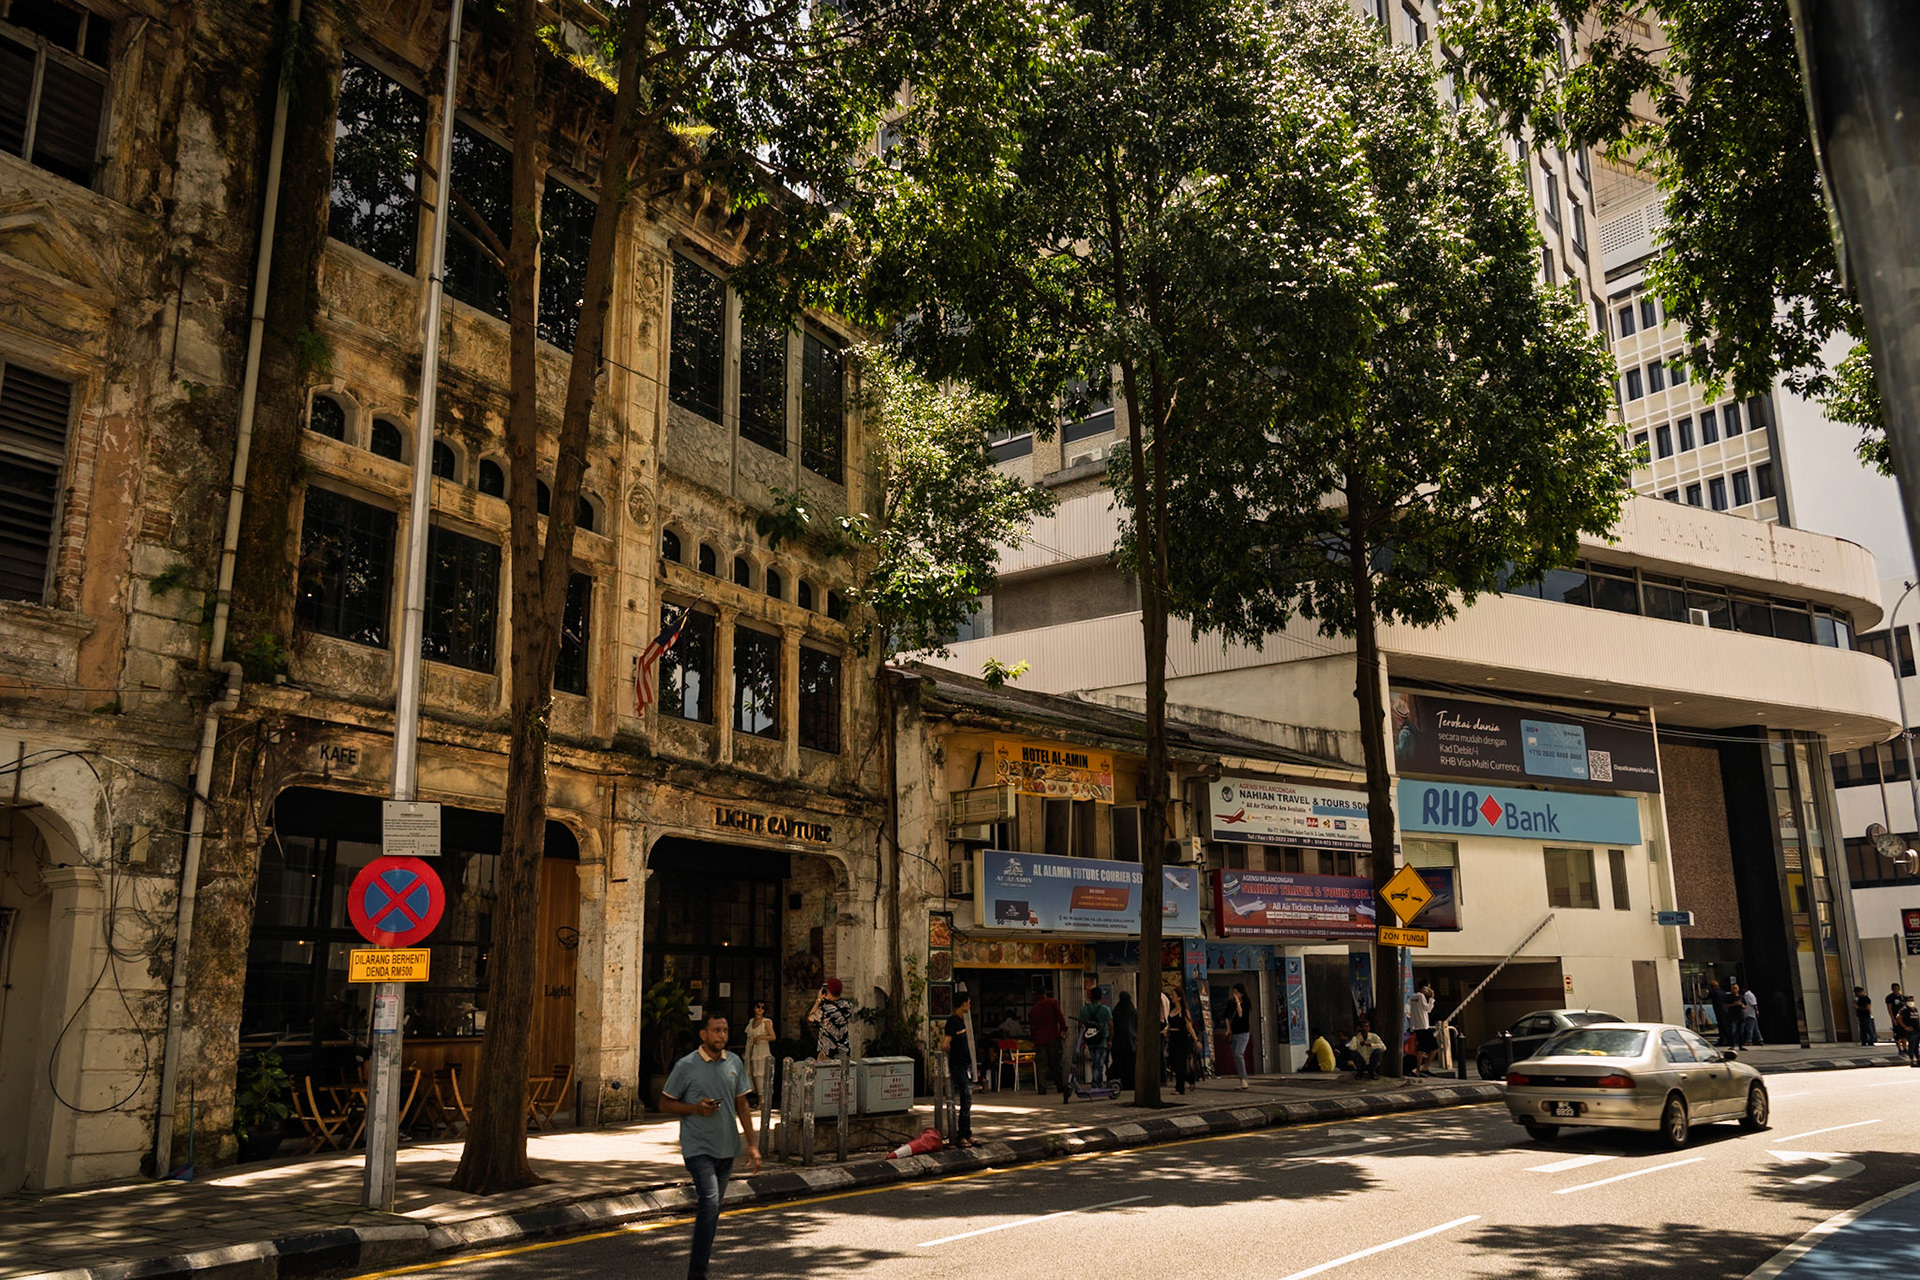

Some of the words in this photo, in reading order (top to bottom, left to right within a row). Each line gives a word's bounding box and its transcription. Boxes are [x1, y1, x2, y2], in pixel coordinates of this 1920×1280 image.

[1436, 710, 1472, 729] Terokai
[1473, 718, 1500, 732] dunia
[1438, 733, 1460, 742] secara
[1460, 735, 1483, 744] mudah
[1483, 737, 1507, 747] dengan
[320, 744, 357, 765] KAFE
[1440, 744, 1453, 753] Kad
[1022, 746, 1050, 764] HOTEL
[1051, 751, 1088, 769] AL-AMIN
[1440, 756, 1456, 767] RHB
[1456, 758, 1472, 768] Visa
[1472, 759, 1490, 769] Multi
[1490, 760, 1521, 773] Currency.
[1259, 784, 1296, 794] PELANCONGAN
[1239, 790, 1275, 801] NAHIAN
[1277, 794, 1310, 805] TRAVEL
[1312, 797, 1319, 806] &
[1321, 798, 1350, 809] TOURS
[1422, 788, 1479, 827] RHB
[1504, 802, 1560, 834] Bank
[715, 807, 764, 832] LIGHT
[767, 816, 832, 842] CAPTURE
[1033, 864, 1043, 877] AL
[1043, 865, 1071, 879] ALAMIN
[1073, 867, 1099, 881] FUTURE
[1100, 870, 1130, 883] COURIER
[1260, 876, 1294, 884] PELANCONGAN
[1241, 882, 1278, 895] NAHIAN
[1281, 885, 1314, 897] TRAVEL
[1322, 887, 1350, 899] TOURS
[1272, 902, 1281, 910] All
[1282, 902, 1290, 911] Air
[1291, 903, 1312, 912] Tickets
[1313, 904, 1322, 912] Are
[1323, 904, 1350, 913] Available
[1383, 932, 1399, 940] ZON
[1402, 934, 1424, 942] TUNDA
[354, 954, 390, 965] DILARANG
[391, 954, 425, 965] BERHENTI
[366, 966, 390, 977] DENDA
[391, 966, 413, 977] RM500
[544, 985, 572, 998] Light
